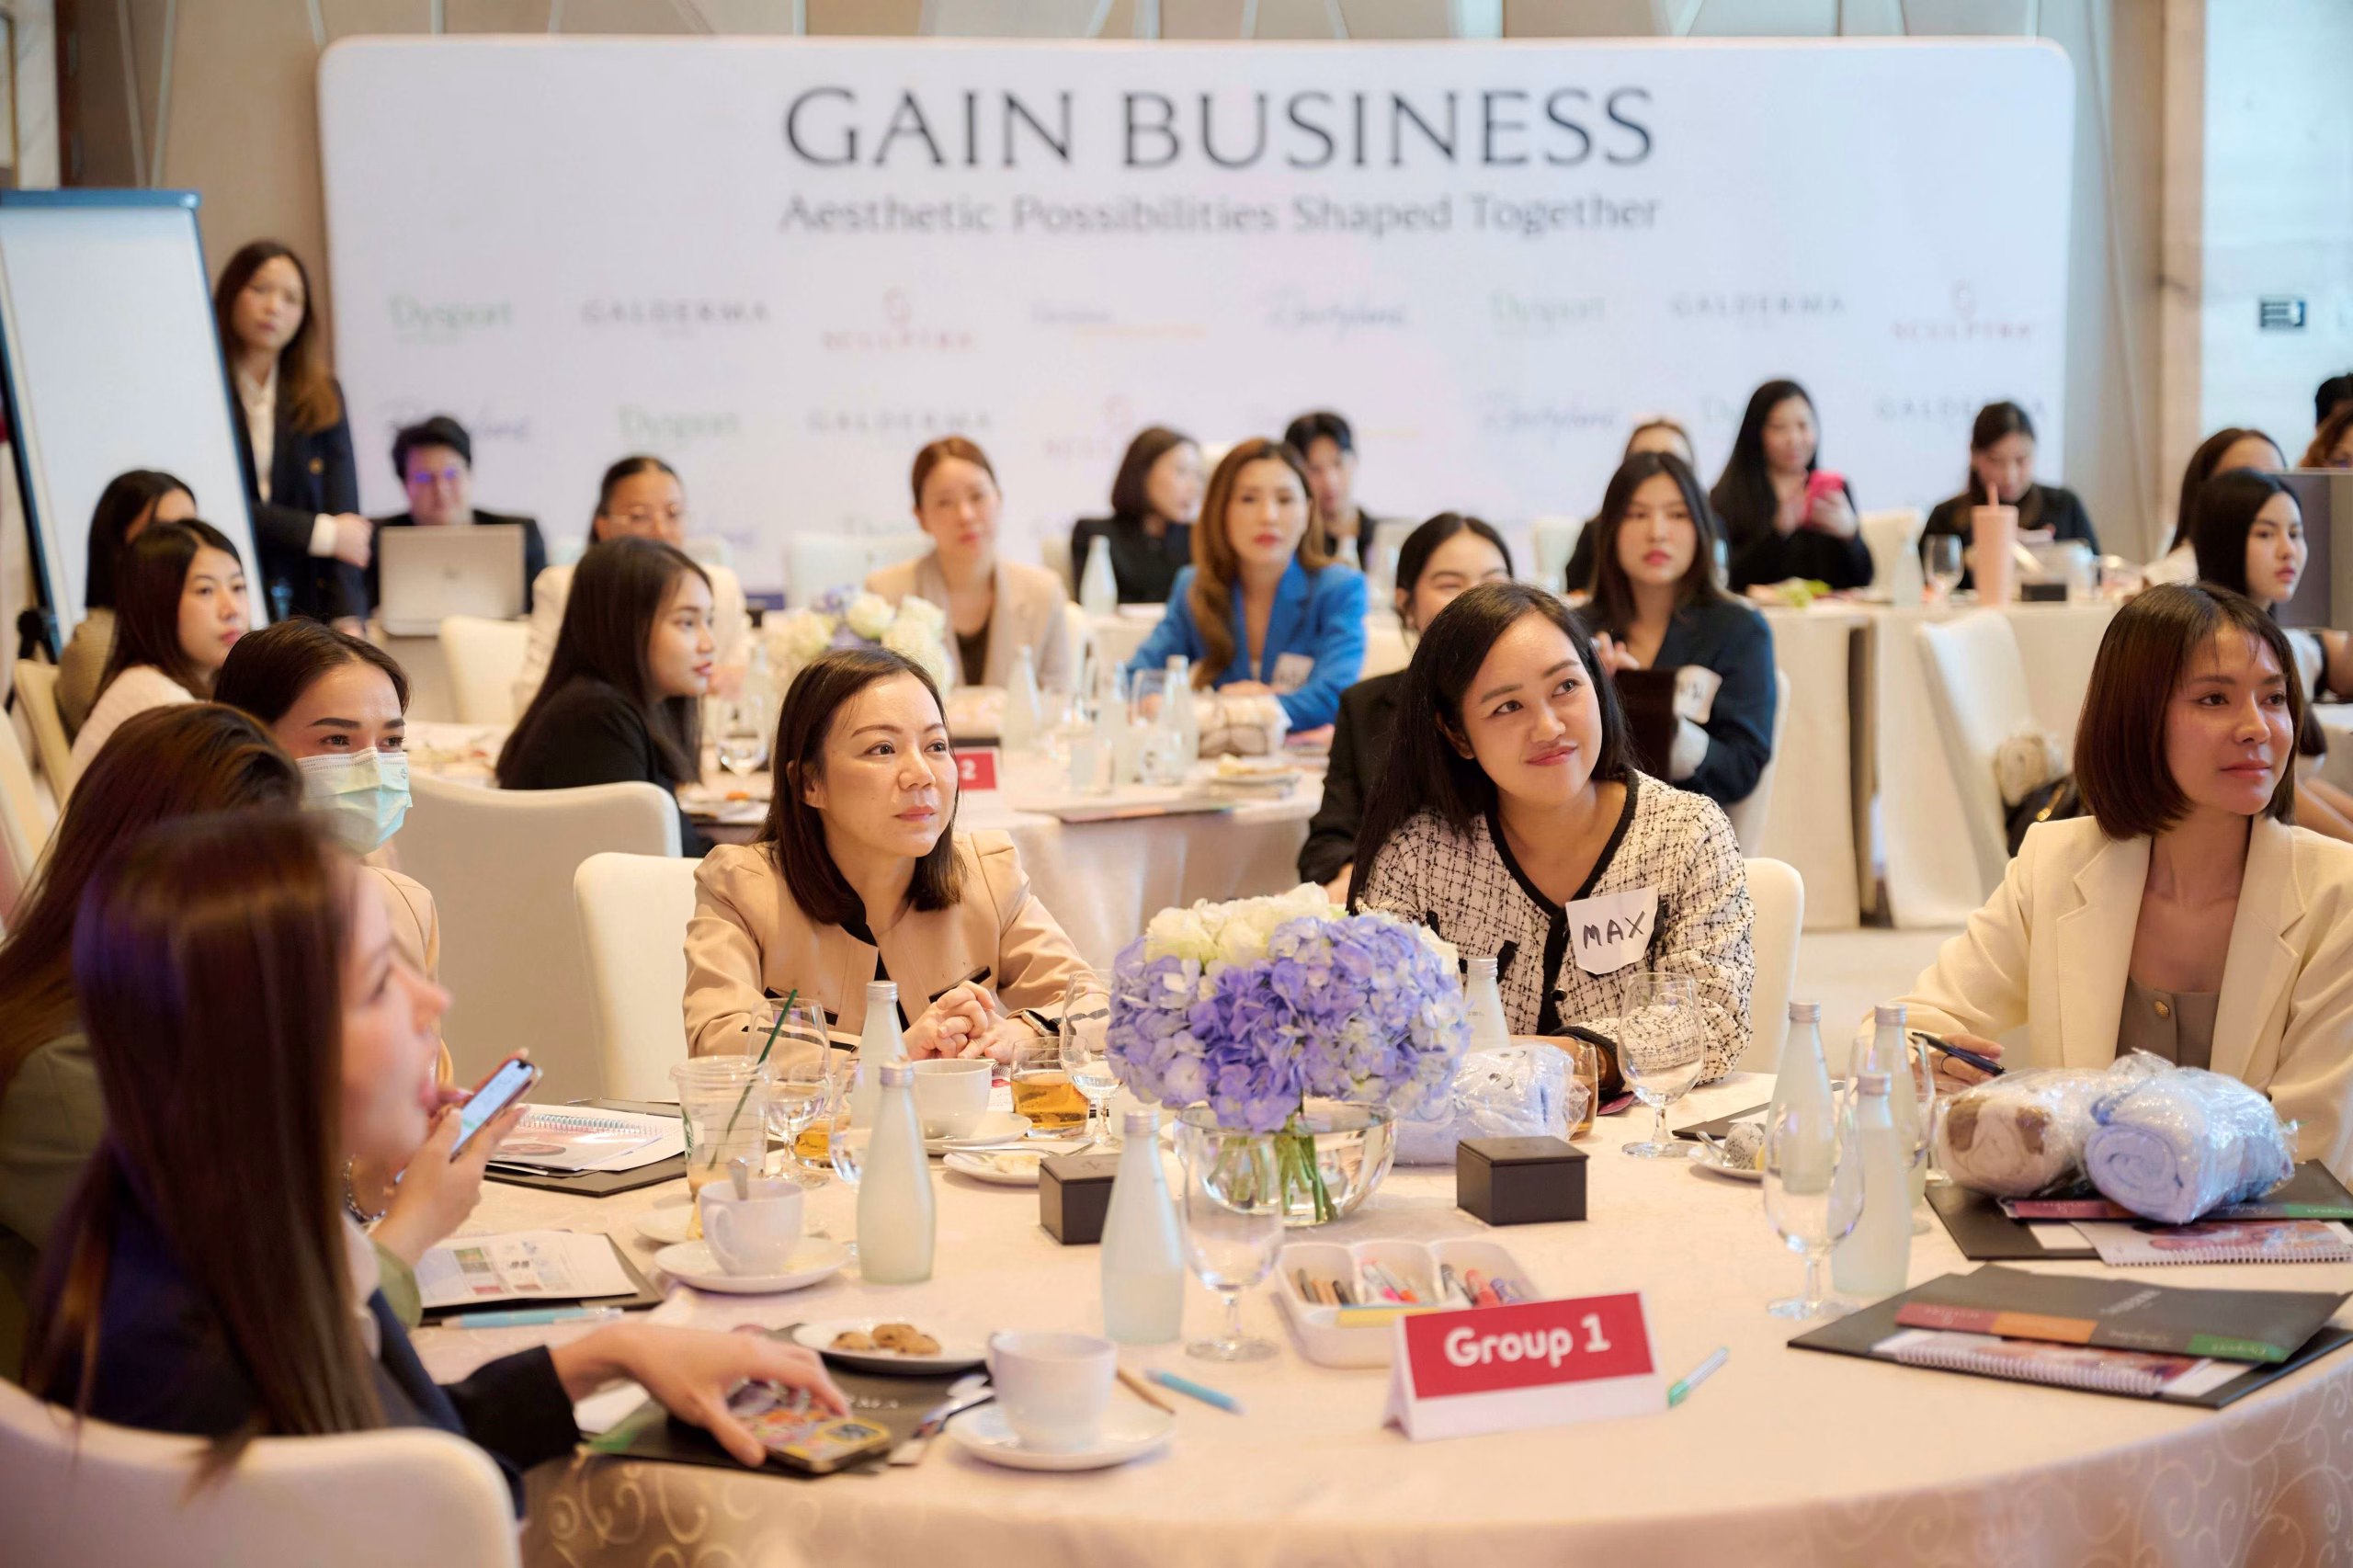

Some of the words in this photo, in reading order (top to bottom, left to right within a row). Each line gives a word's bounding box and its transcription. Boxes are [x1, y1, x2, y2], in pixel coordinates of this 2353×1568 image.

[784, 85, 1073, 169] GAIN
[1121, 85, 1655, 170] BUSINESS
[779, 194, 995, 232] Aesthetic
[1012, 194, 1278, 233] Possibilities
[1291, 196, 1453, 237] Shaped
[1470, 196, 1662, 237] Together
[961, 759, 977, 780] 2
[1583, 911, 1646, 949] MAX
[1444, 1325, 1574, 1369] Group
[1581, 1313, 1611, 1353] 1
